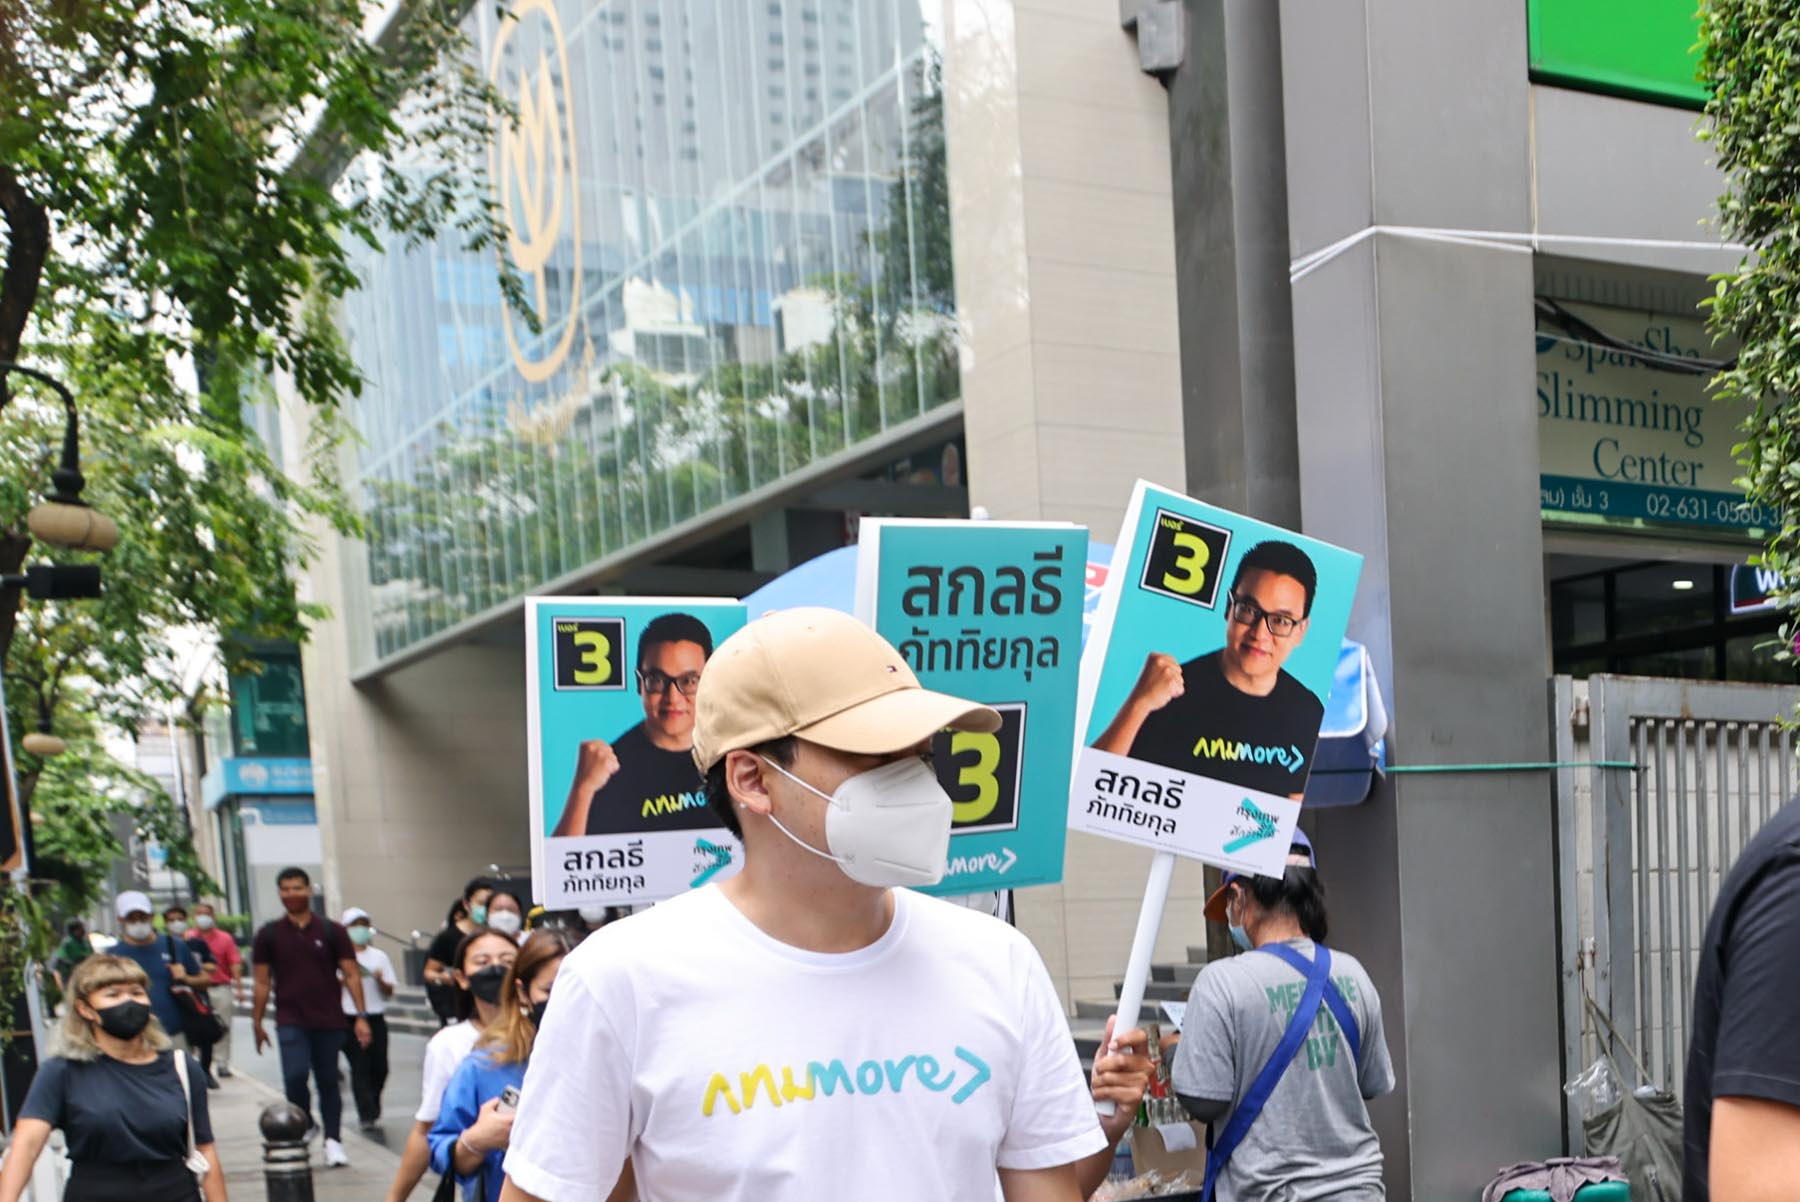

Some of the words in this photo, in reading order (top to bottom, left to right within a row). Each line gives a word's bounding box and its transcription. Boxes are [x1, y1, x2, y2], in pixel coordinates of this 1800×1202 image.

[1537, 370, 1704, 448] Slimming
[1593, 437, 1704, 486] Center
[1599, 490, 1609, 510] 3
[901, 544, 1064, 617] สกลธี
[1162, 531, 1210, 595] 3
[573, 630, 613, 685] 3
[951, 730, 1001, 823] 3
[1094, 768, 1186, 810] สกลธี
[1086, 794, 1177, 838] ภัททิยกุล
[563, 840, 645, 872] สกลธี
[563, 872, 645, 894] ภัททิยกุล
